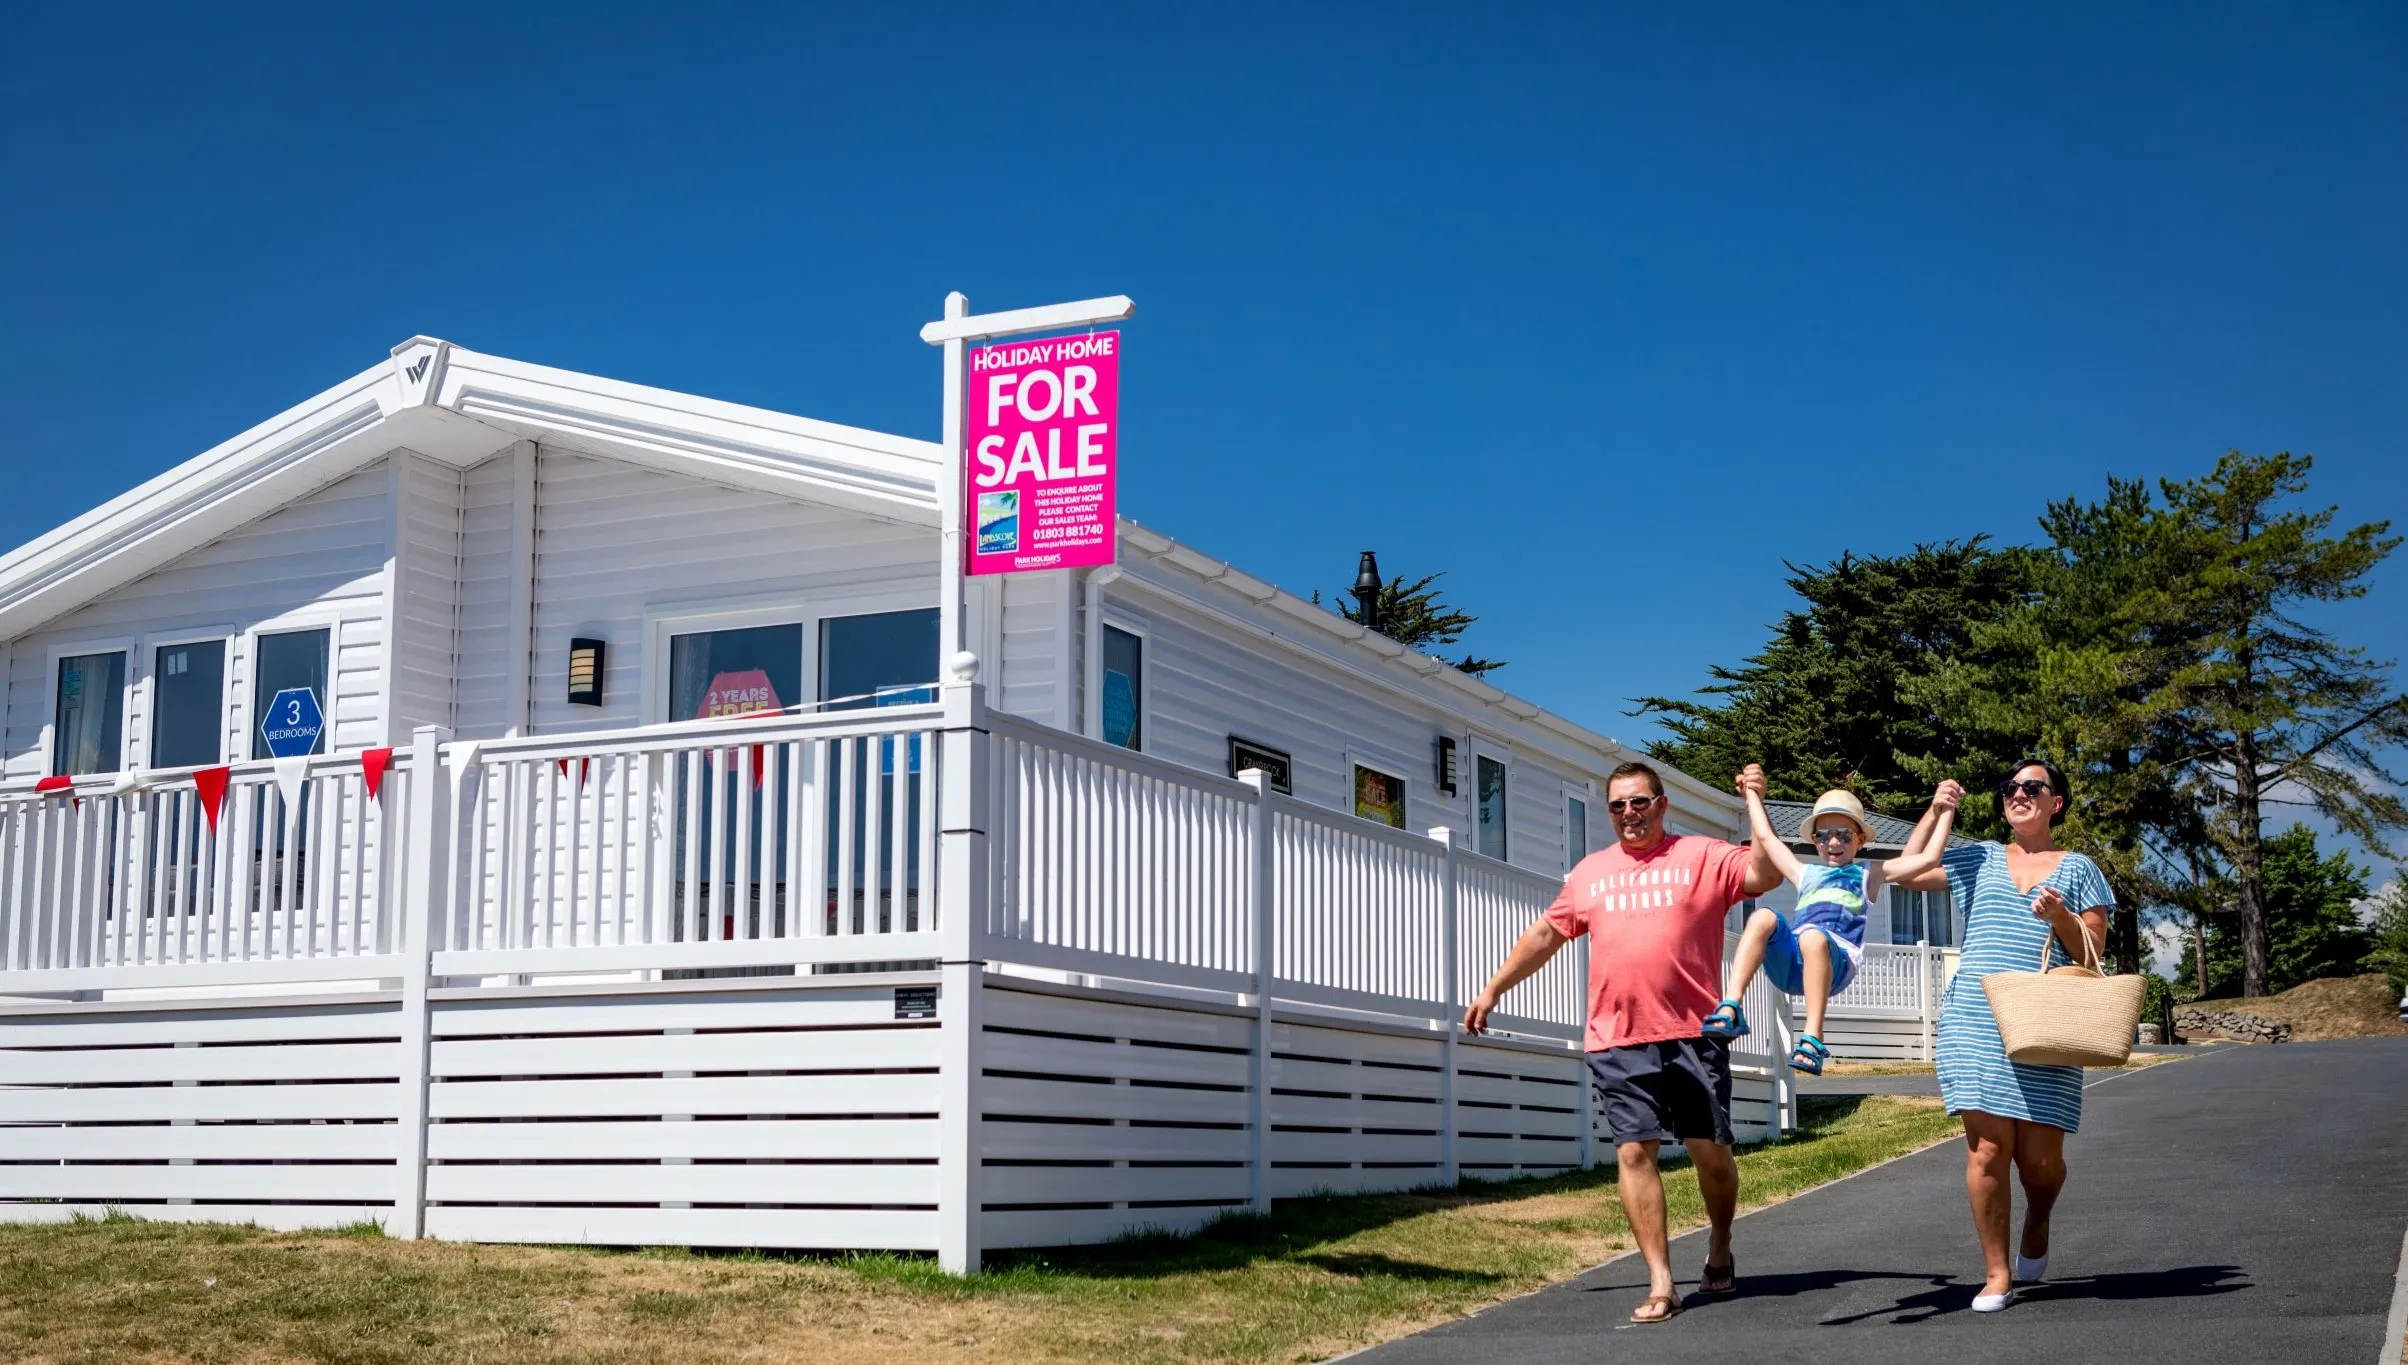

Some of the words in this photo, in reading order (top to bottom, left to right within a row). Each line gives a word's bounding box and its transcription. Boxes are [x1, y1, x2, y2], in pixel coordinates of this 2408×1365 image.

[974, 345, 1053, 371] HOLIDAY
[1056, 338, 1114, 361] HOME
[988, 365, 1100, 427] FOR
[975, 423, 1108, 487] SALE
[1047, 486, 1077, 496] ENQUIRE
[1078, 484, 1103, 493] ABOUT
[1050, 496, 1081, 505] HOLIDAY
[1082, 494, 1103, 502] HOME
[1039, 507, 1063, 516] PLEASE
[1065, 504, 1098, 513] CONTACT
[1039, 518, 1053, 526] OUR
[1055, 516, 1075, 524] SALES
[1076, 514, 1098, 522] TEAM:
[1033, 527, 1064, 540] 01803
[1066, 524, 1103, 537] 881740
[1034, 538, 1103, 549] www.parkholidays.com
[1015, 556, 1030, 565] PARK
[1031, 554, 1061, 563] HOLIDAYS
[710, 691, 718, 705] 2
[722, 687, 769, 703] YEARS
[286, 700, 300, 725] 3
[269, 727, 317, 740] BEDROOMS
[1590, 868, 1691, 897] CALIFORNIA
[1604, 888, 1673, 912] MOTORS
